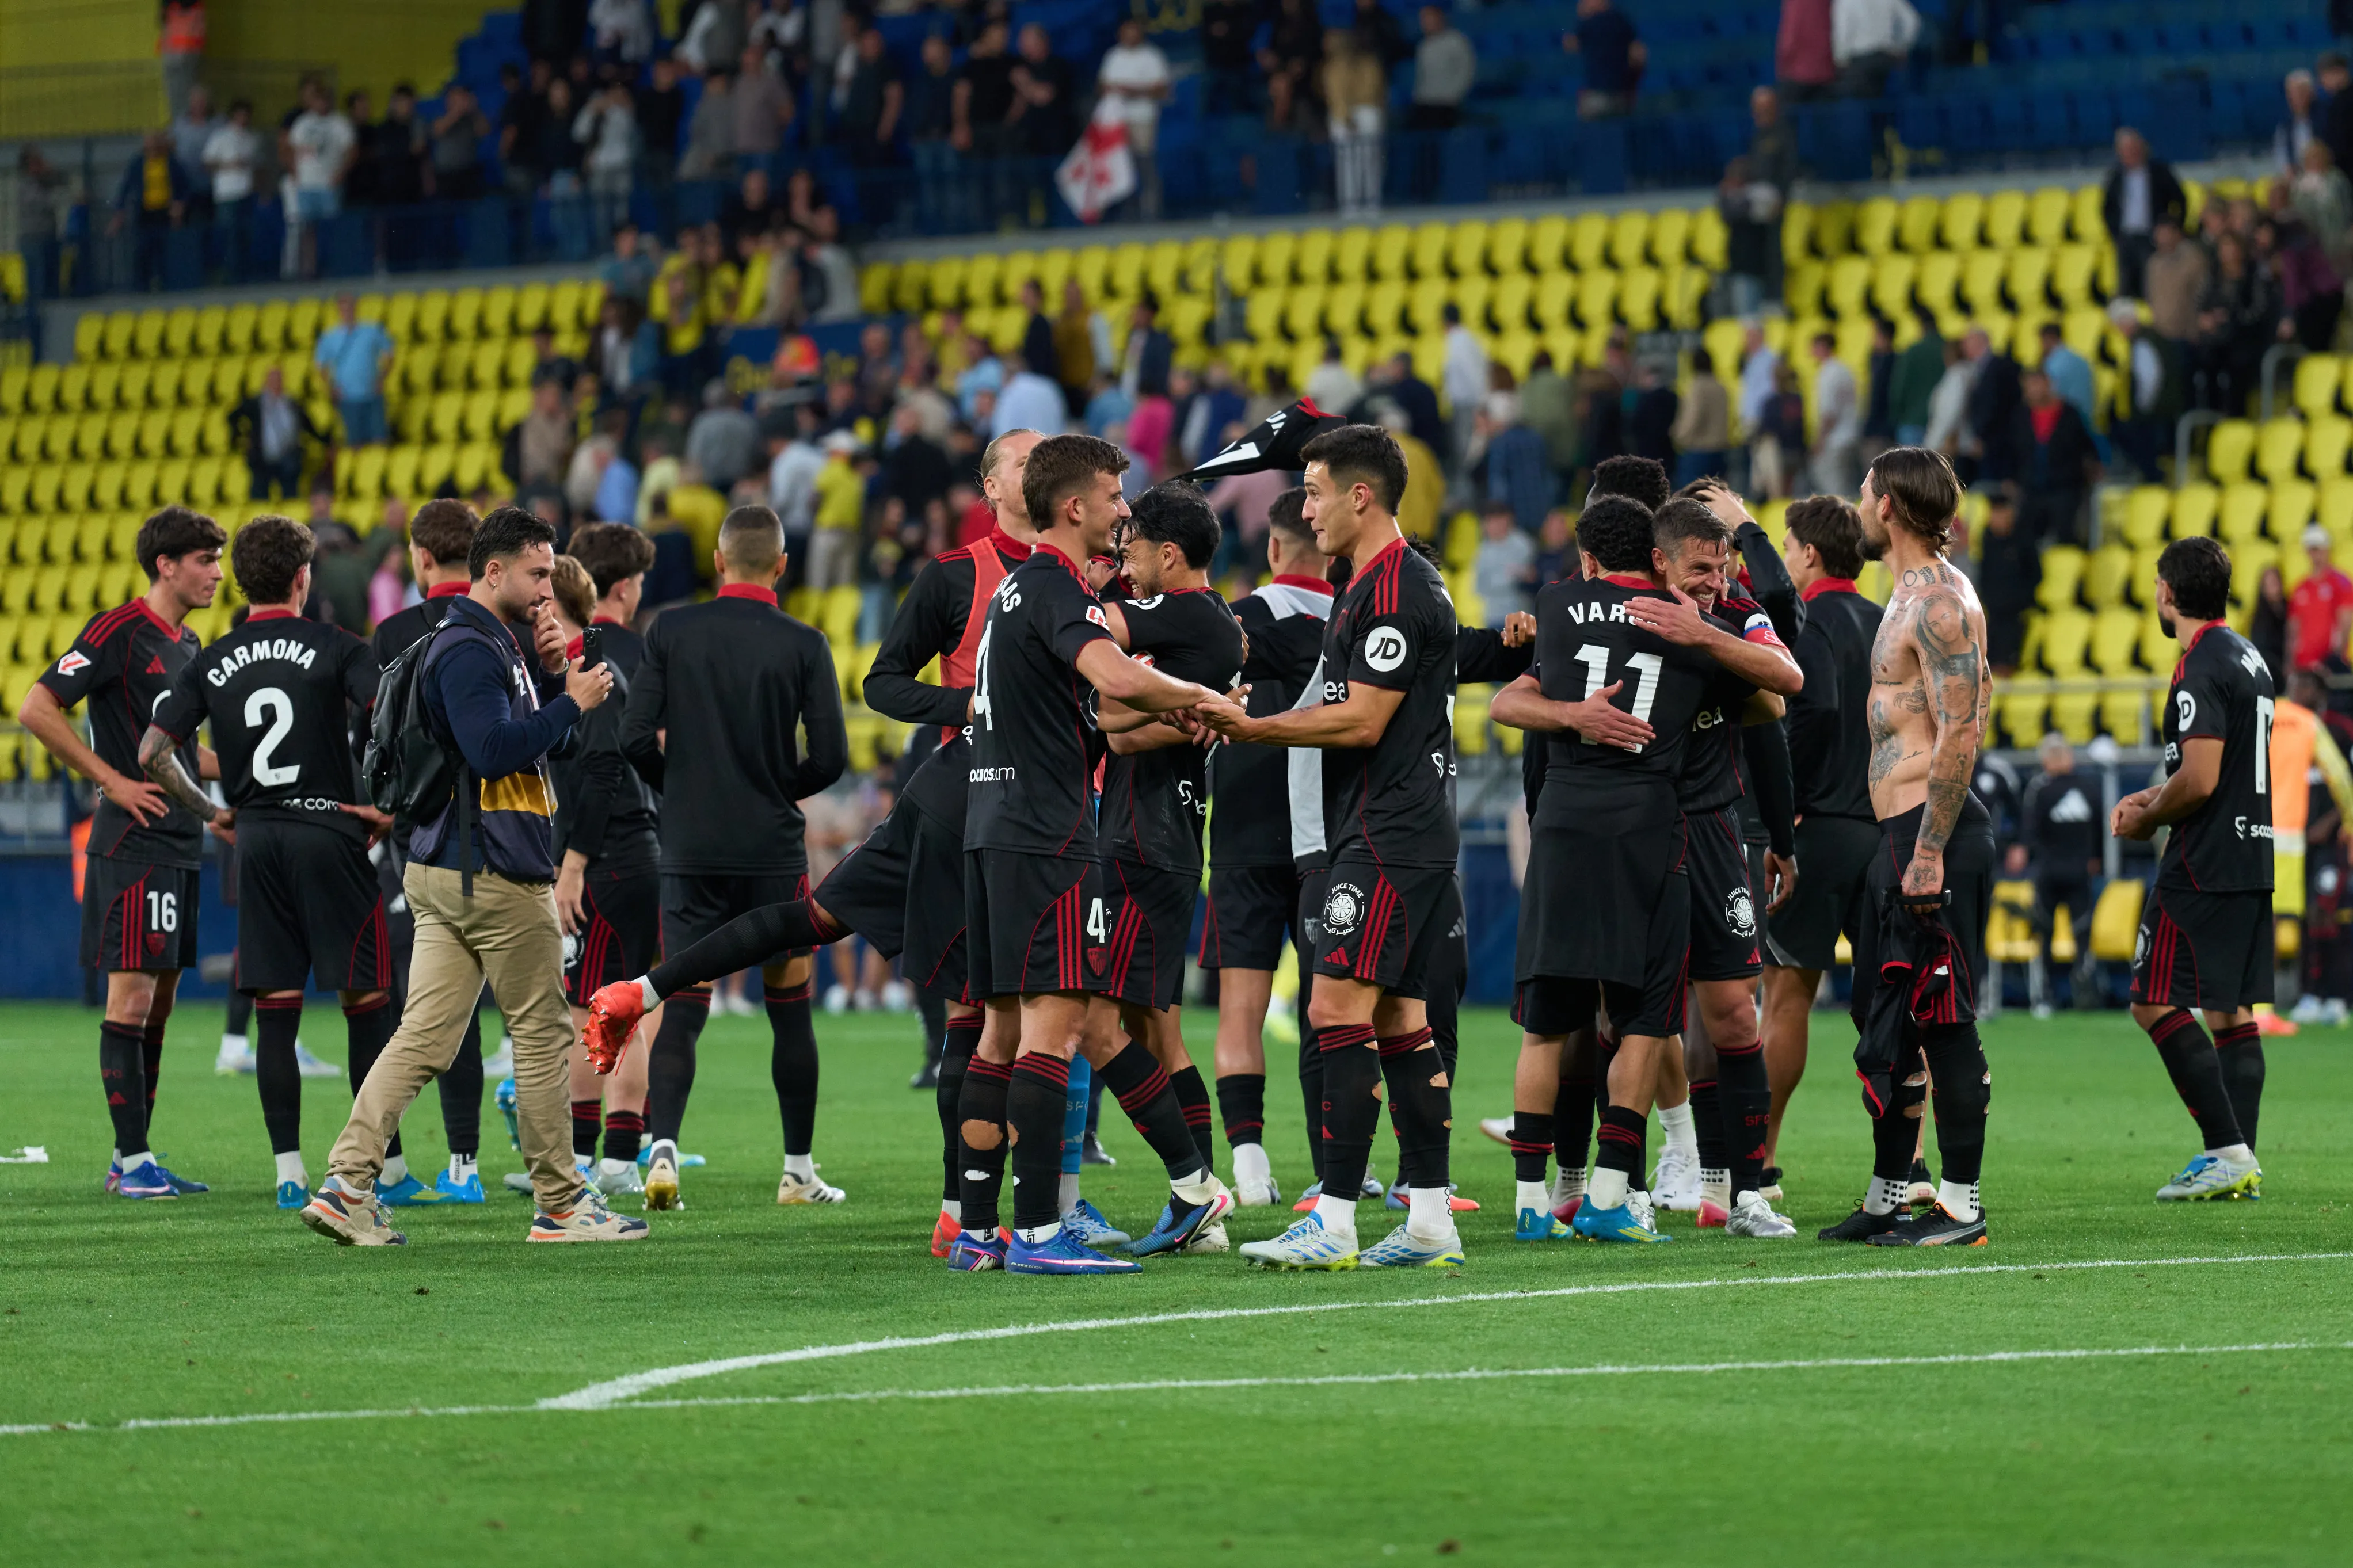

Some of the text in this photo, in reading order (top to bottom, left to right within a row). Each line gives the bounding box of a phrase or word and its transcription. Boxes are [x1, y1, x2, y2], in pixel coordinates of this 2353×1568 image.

[207, 638, 316, 687] CARMONA
[1369, 637, 1401, 660] JD
[974, 620, 993, 731] 4
[1574, 644, 1663, 754] 11
[244, 687, 300, 787] 2
[147, 891, 177, 933] 16
[1331, 883, 1364, 898] JUICE TIME
[1727, 887, 1741, 901] JUICE
[1086, 898, 1106, 943] 4
